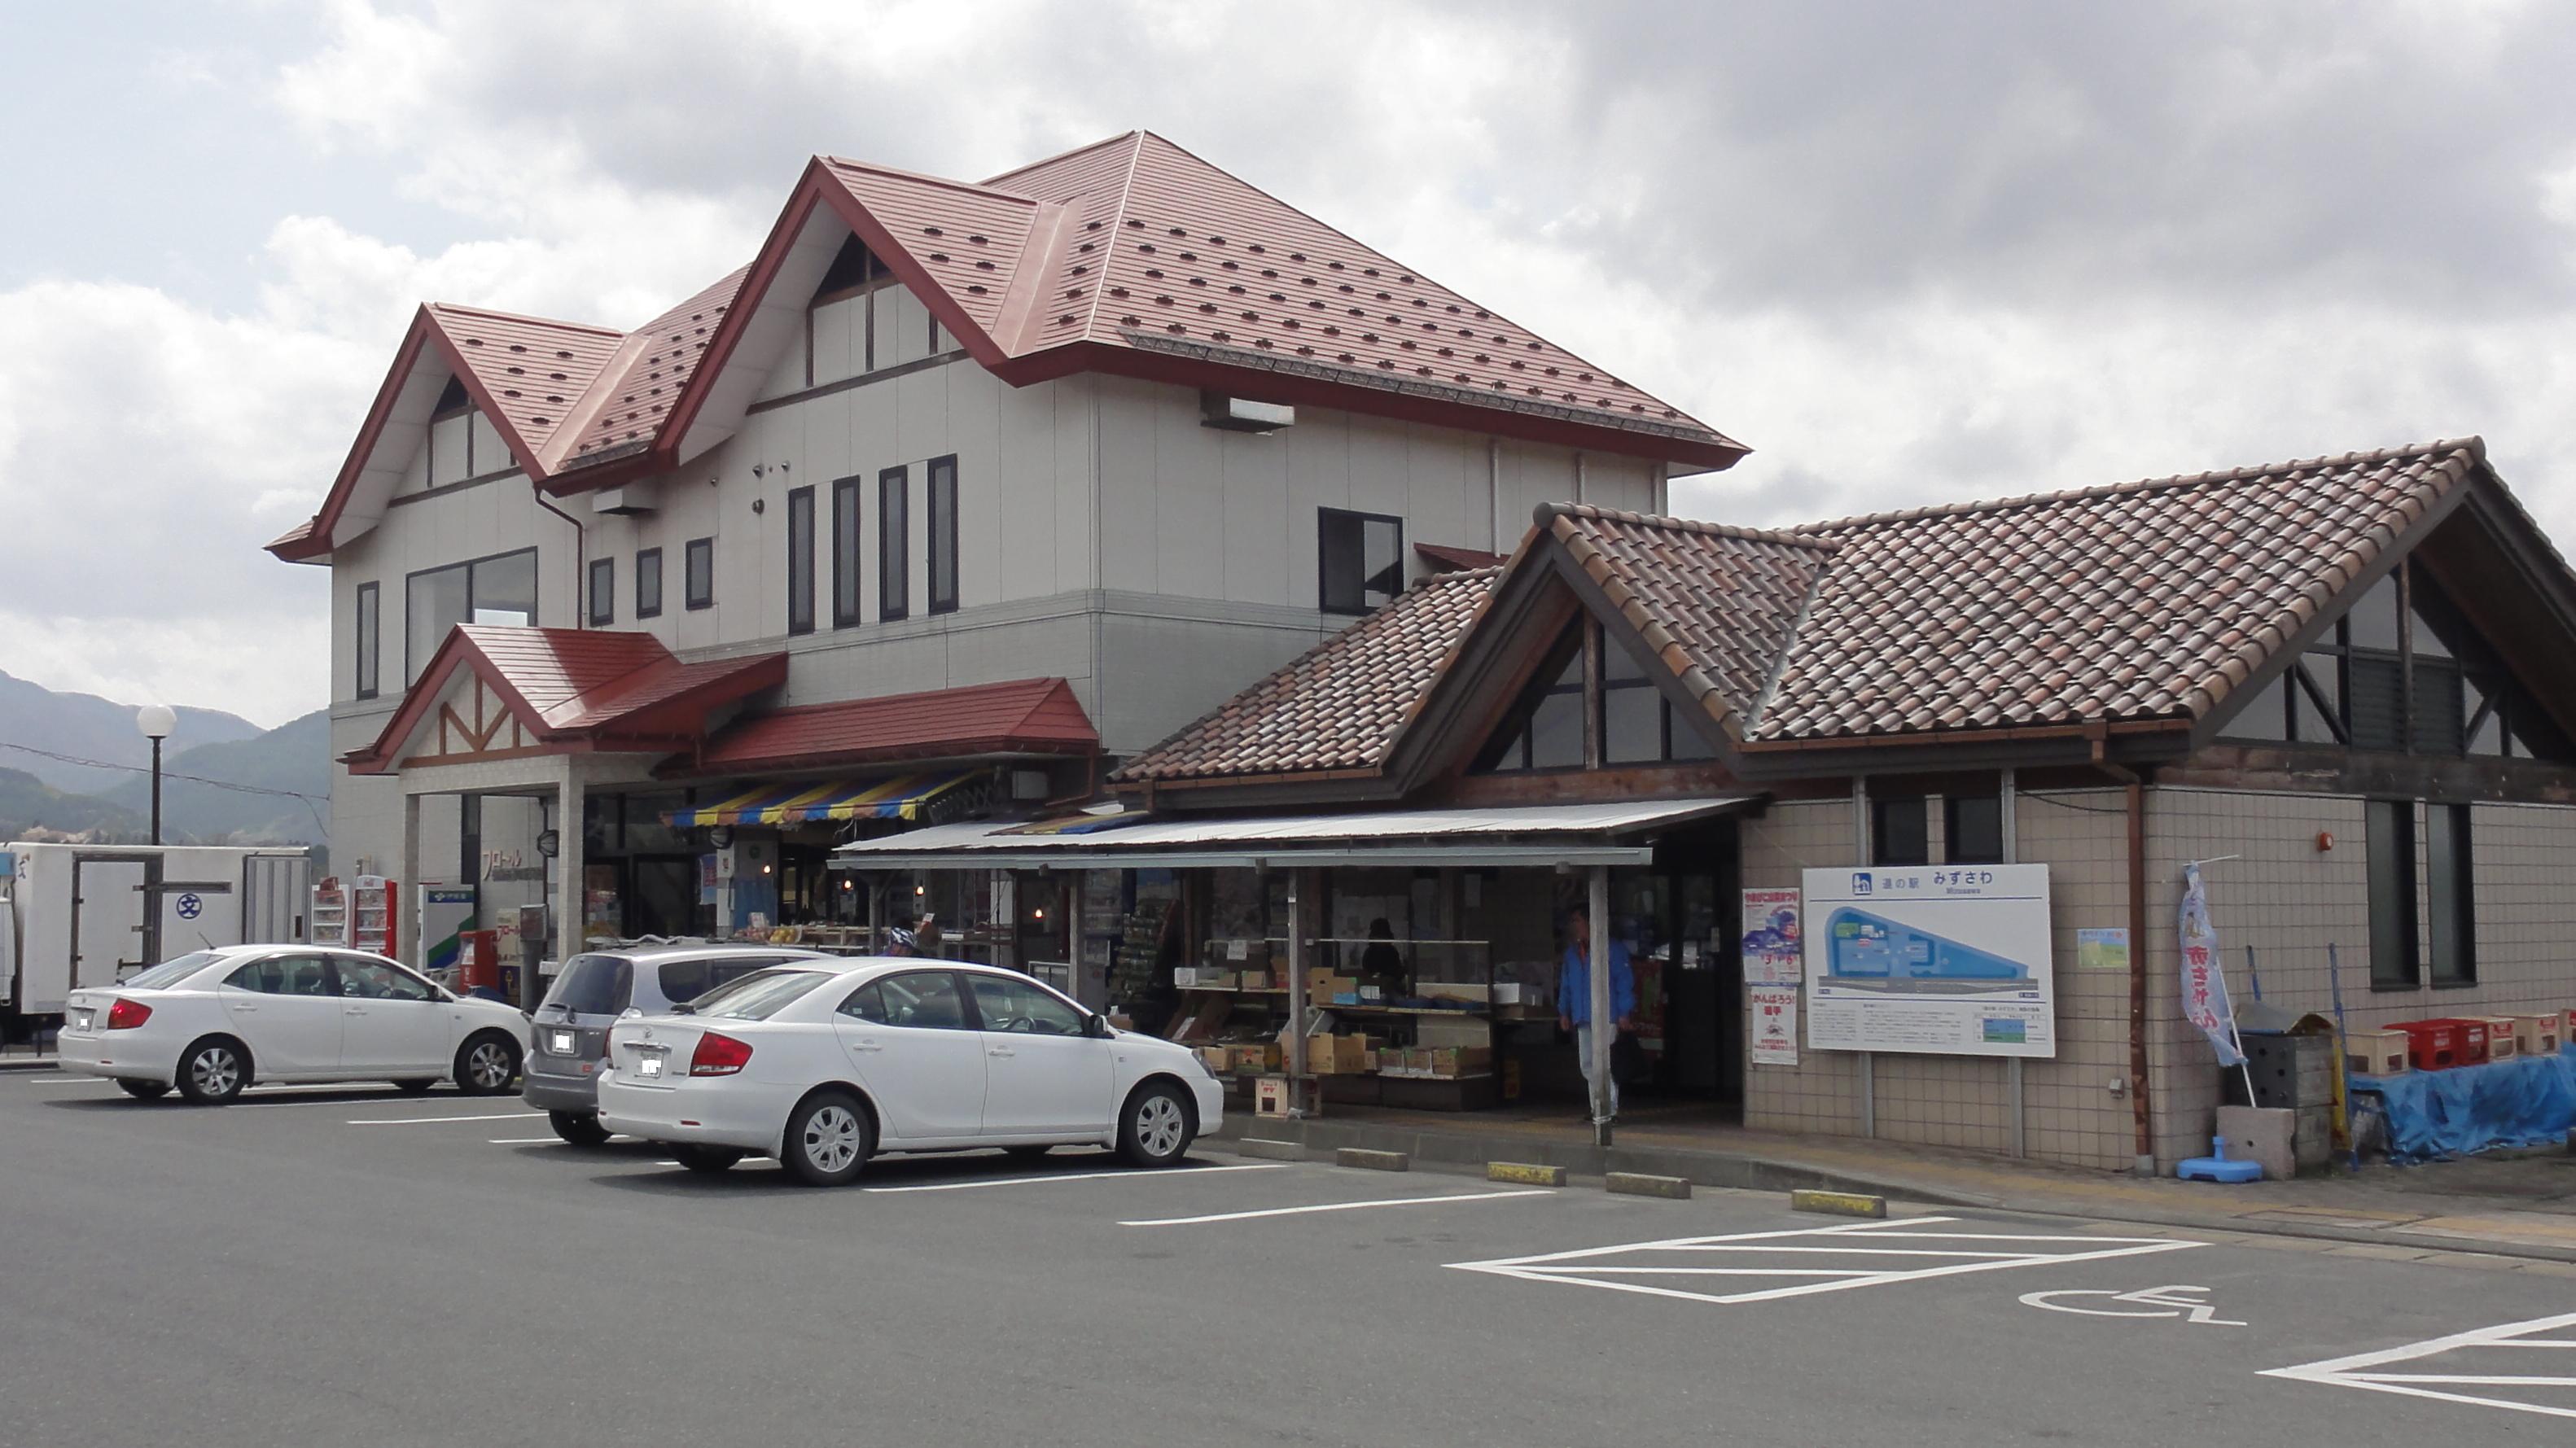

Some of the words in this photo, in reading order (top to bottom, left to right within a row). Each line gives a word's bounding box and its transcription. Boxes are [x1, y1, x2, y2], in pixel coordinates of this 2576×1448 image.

[1882, 877, 1919, 890] 道の駅
[1933, 870, 1993, 886] みずさわ
